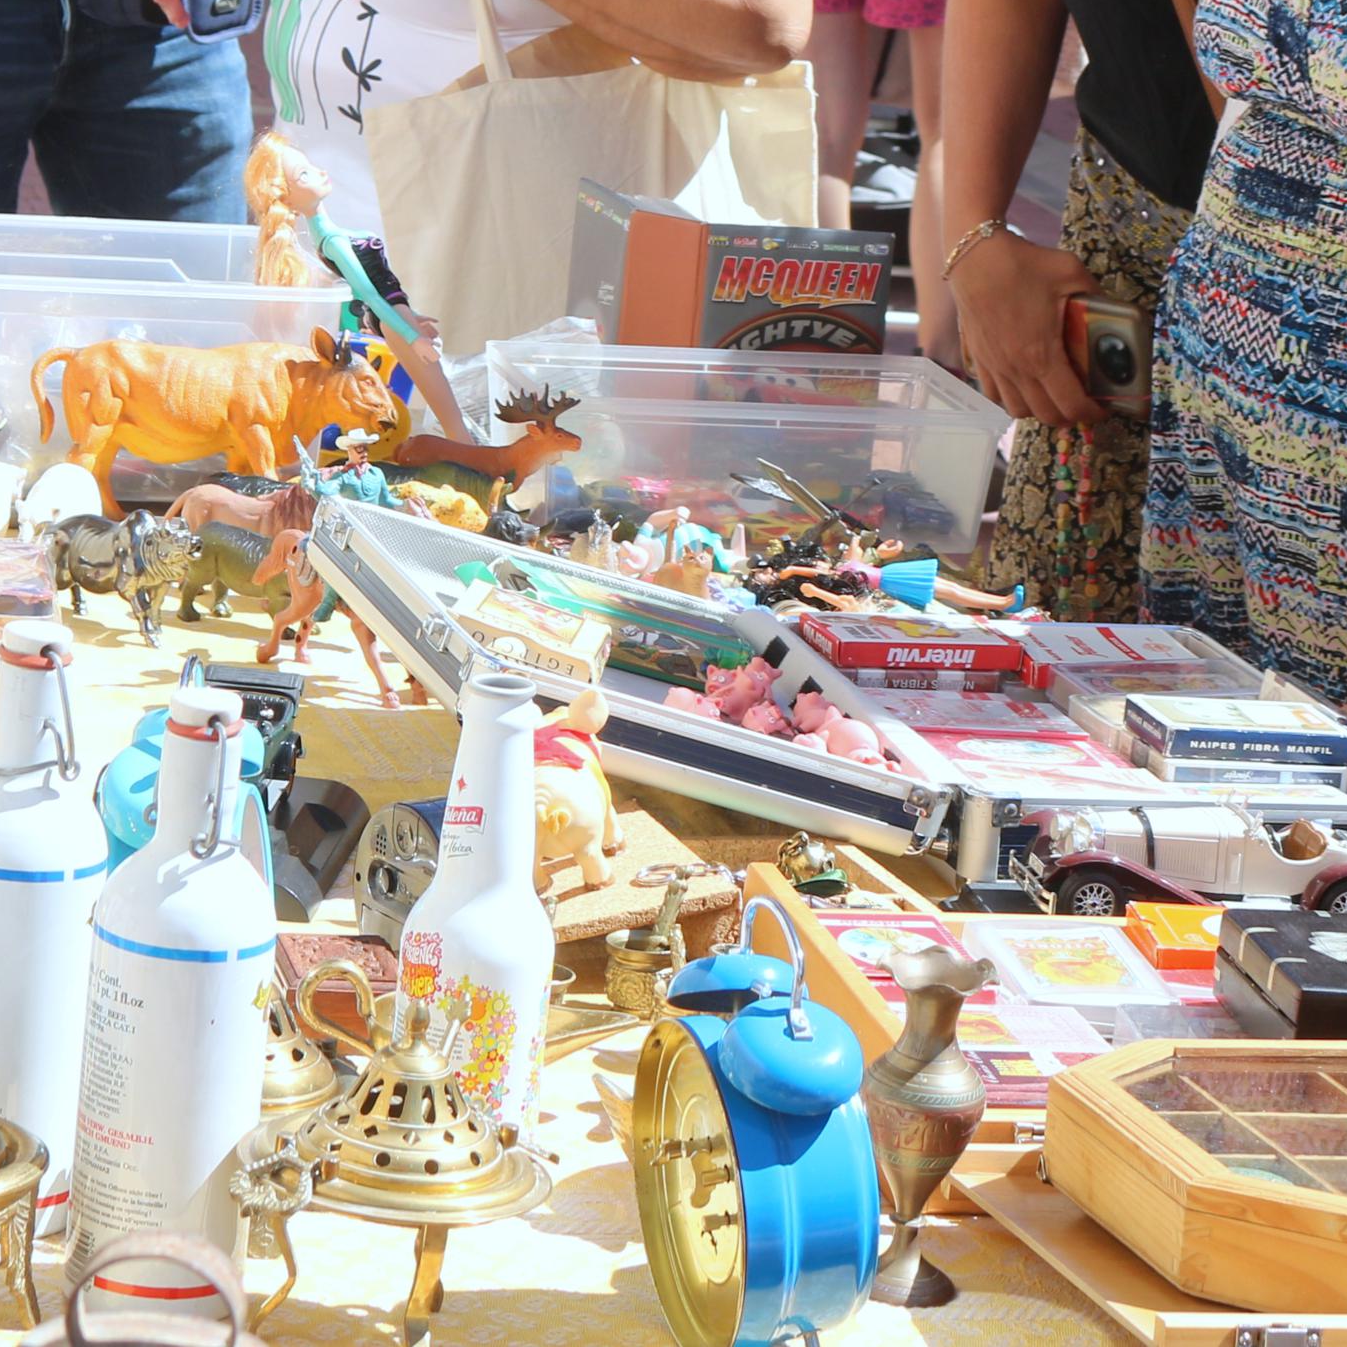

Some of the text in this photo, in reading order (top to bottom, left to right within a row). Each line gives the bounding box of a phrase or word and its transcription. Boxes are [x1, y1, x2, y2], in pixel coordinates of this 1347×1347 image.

[712, 256, 882, 308] MCQUEEN
[887, 647, 976, 668] interviú
[891, 678, 926, 689] FIBRA
[1190, 740, 1333, 755] NAIPES FIBRA MARFIL
[99, 969, 121, 988] Cont.
